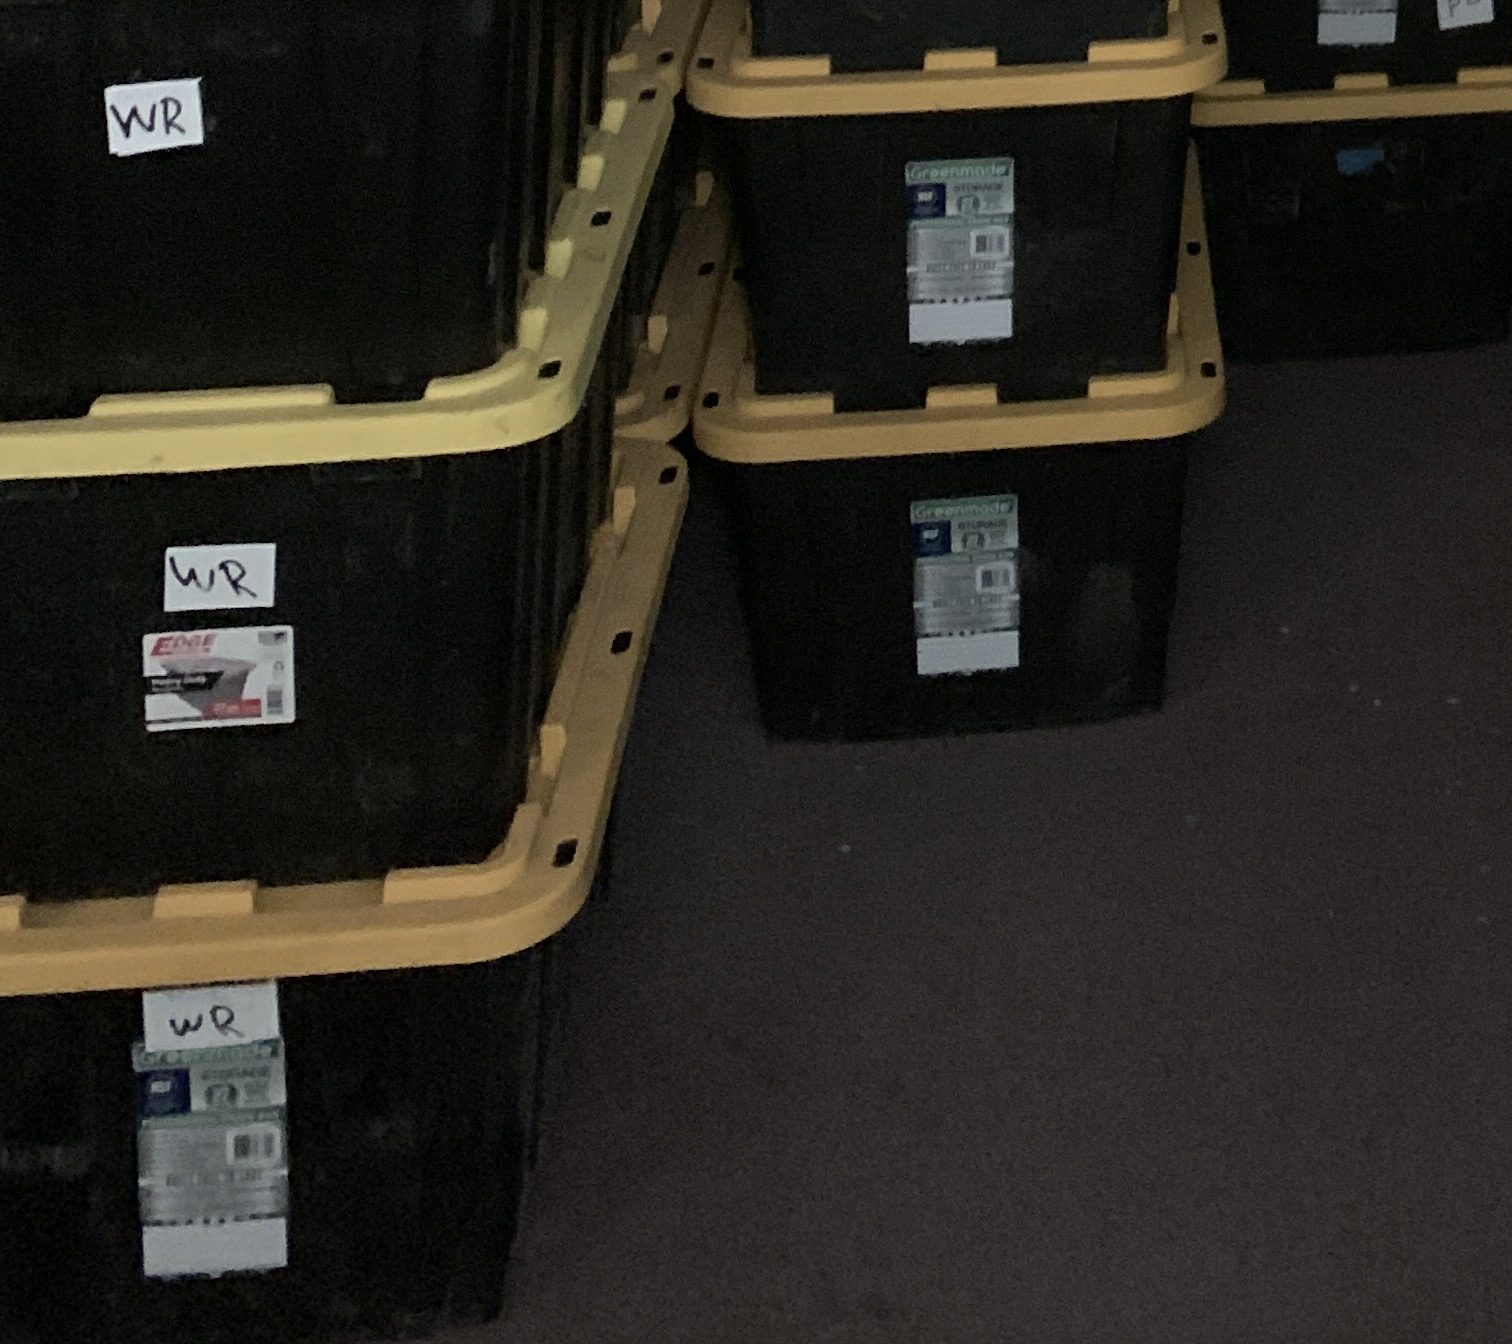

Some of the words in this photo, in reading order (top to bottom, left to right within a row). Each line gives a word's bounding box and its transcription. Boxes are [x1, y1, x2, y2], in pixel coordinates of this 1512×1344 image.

[110, 96, 186, 139] WR
[169, 556, 257, 598] WR
[169, 1005, 245, 1037] WR
